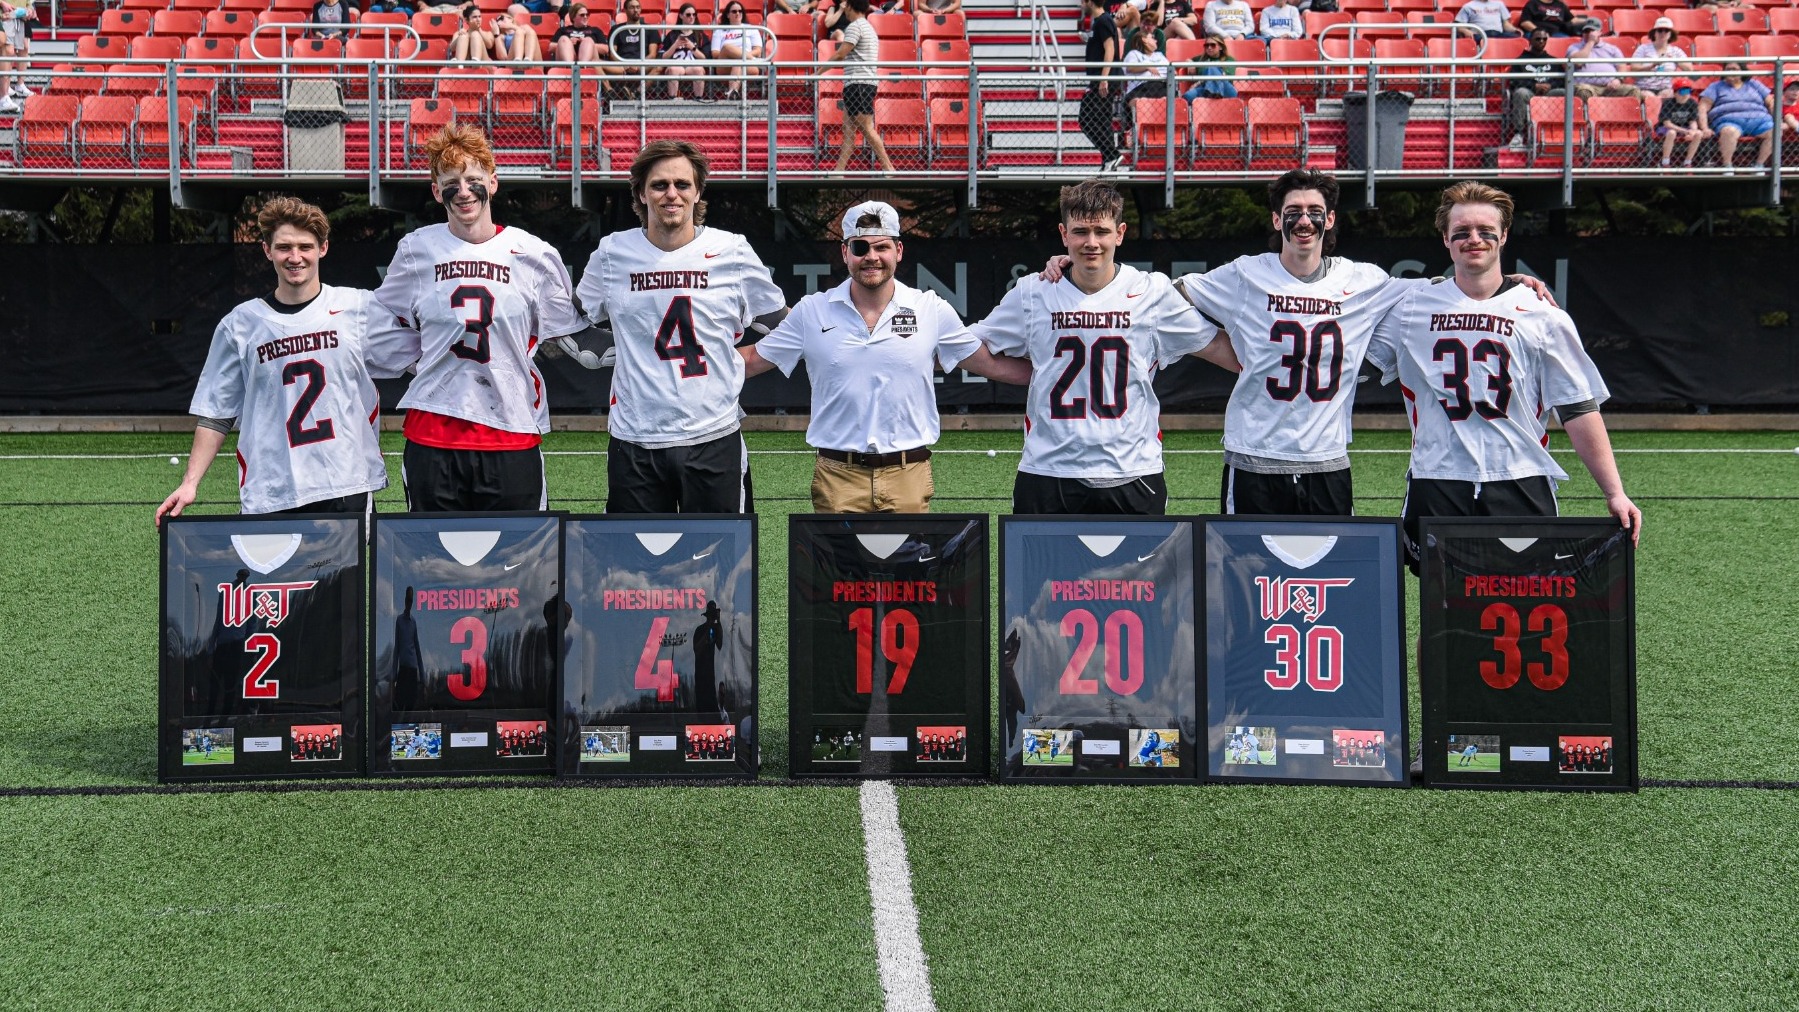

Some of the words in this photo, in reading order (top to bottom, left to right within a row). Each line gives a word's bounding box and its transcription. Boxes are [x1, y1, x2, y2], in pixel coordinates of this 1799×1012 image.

[434, 260, 512, 285] PRESIDENTS
[630, 270, 709, 292] PRESIDENTS
[1267, 293, 1342, 316] PRESIDENTS
[256, 330, 339, 364] PRESIDENTS
[450, 285, 495, 365] 3
[655, 295, 708, 379] 4
[1051, 311, 1131, 331] PRESIDENTS
[1430, 313, 1514, 338] PRESIDENTS
[1050, 336, 1130, 420] 20
[1265, 319, 1344, 402] 30
[1432, 338, 1512, 422] 33
[282, 358, 335, 449] 2
[416, 588, 520, 611] PRESIDENTS
[602, 588, 707, 611] PRESIDENTS
[832, 581, 938, 603] PRESIDENTS
[1051, 580, 1155, 601] PRESIDENTS
[1464, 575, 1577, 599] PRESIDENTS
[243, 633, 280, 699] 2
[446, 616, 488, 701] 3
[634, 616, 679, 702] 4
[848, 608, 920, 694] 19
[1059, 608, 1144, 695] 20
[1264, 624, 1344, 691] 30
[1479, 602, 1570, 691] 33
